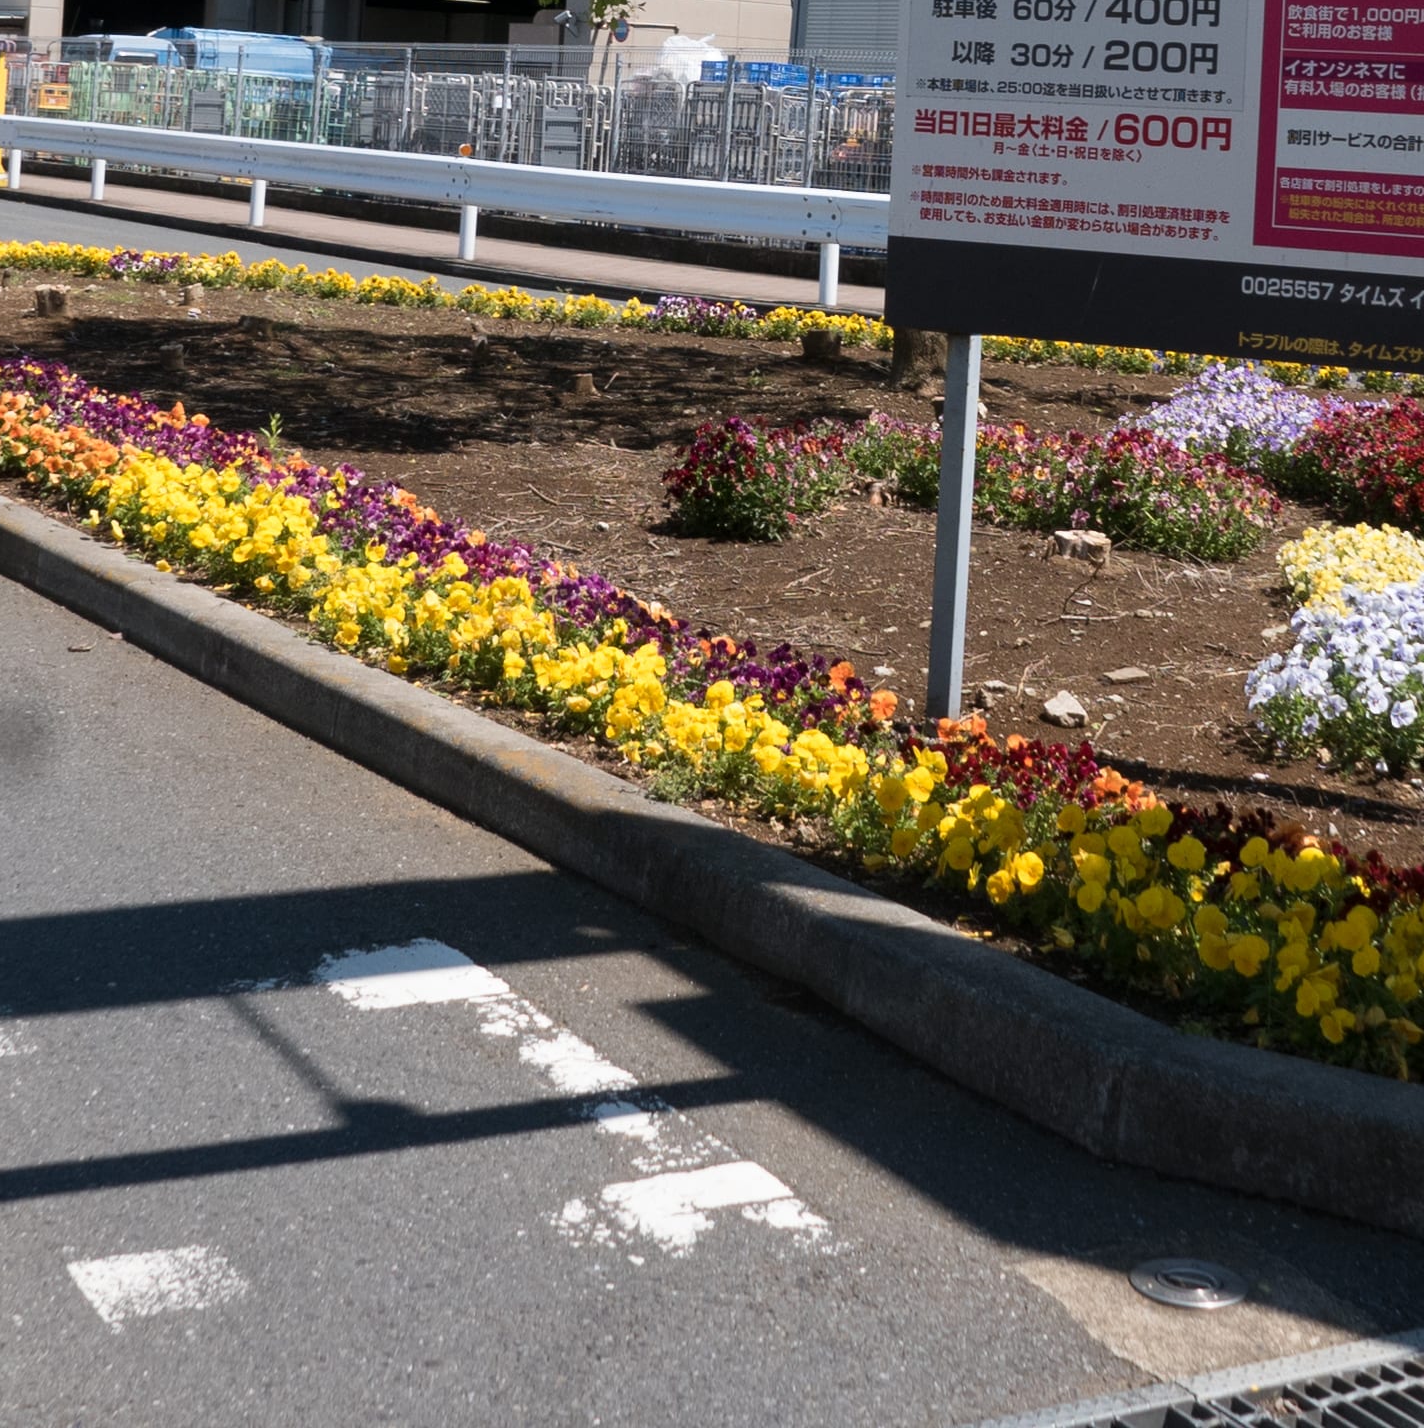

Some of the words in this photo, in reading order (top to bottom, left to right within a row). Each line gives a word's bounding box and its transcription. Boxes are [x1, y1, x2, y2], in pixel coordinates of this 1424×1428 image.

[1084, 0, 1097, 22] /
[1288, 23, 1393, 41] ご利用のお客様
[952, 40, 995, 66] 以降
[1010, 43, 1074, 68] 30分
[1082, 45, 1095, 68] /
[1103, 40, 1219, 74] 200円
[1284, 60, 1406, 80] イオンシネマに
[914, 109, 1089, 142] 当日1日最大料金
[1097, 118, 1108, 141] /
[1114, 113, 1233, 151] 600円
[1241, 275, 1334, 301] 0025557
[1339, 283, 1405, 308] タイムズ
